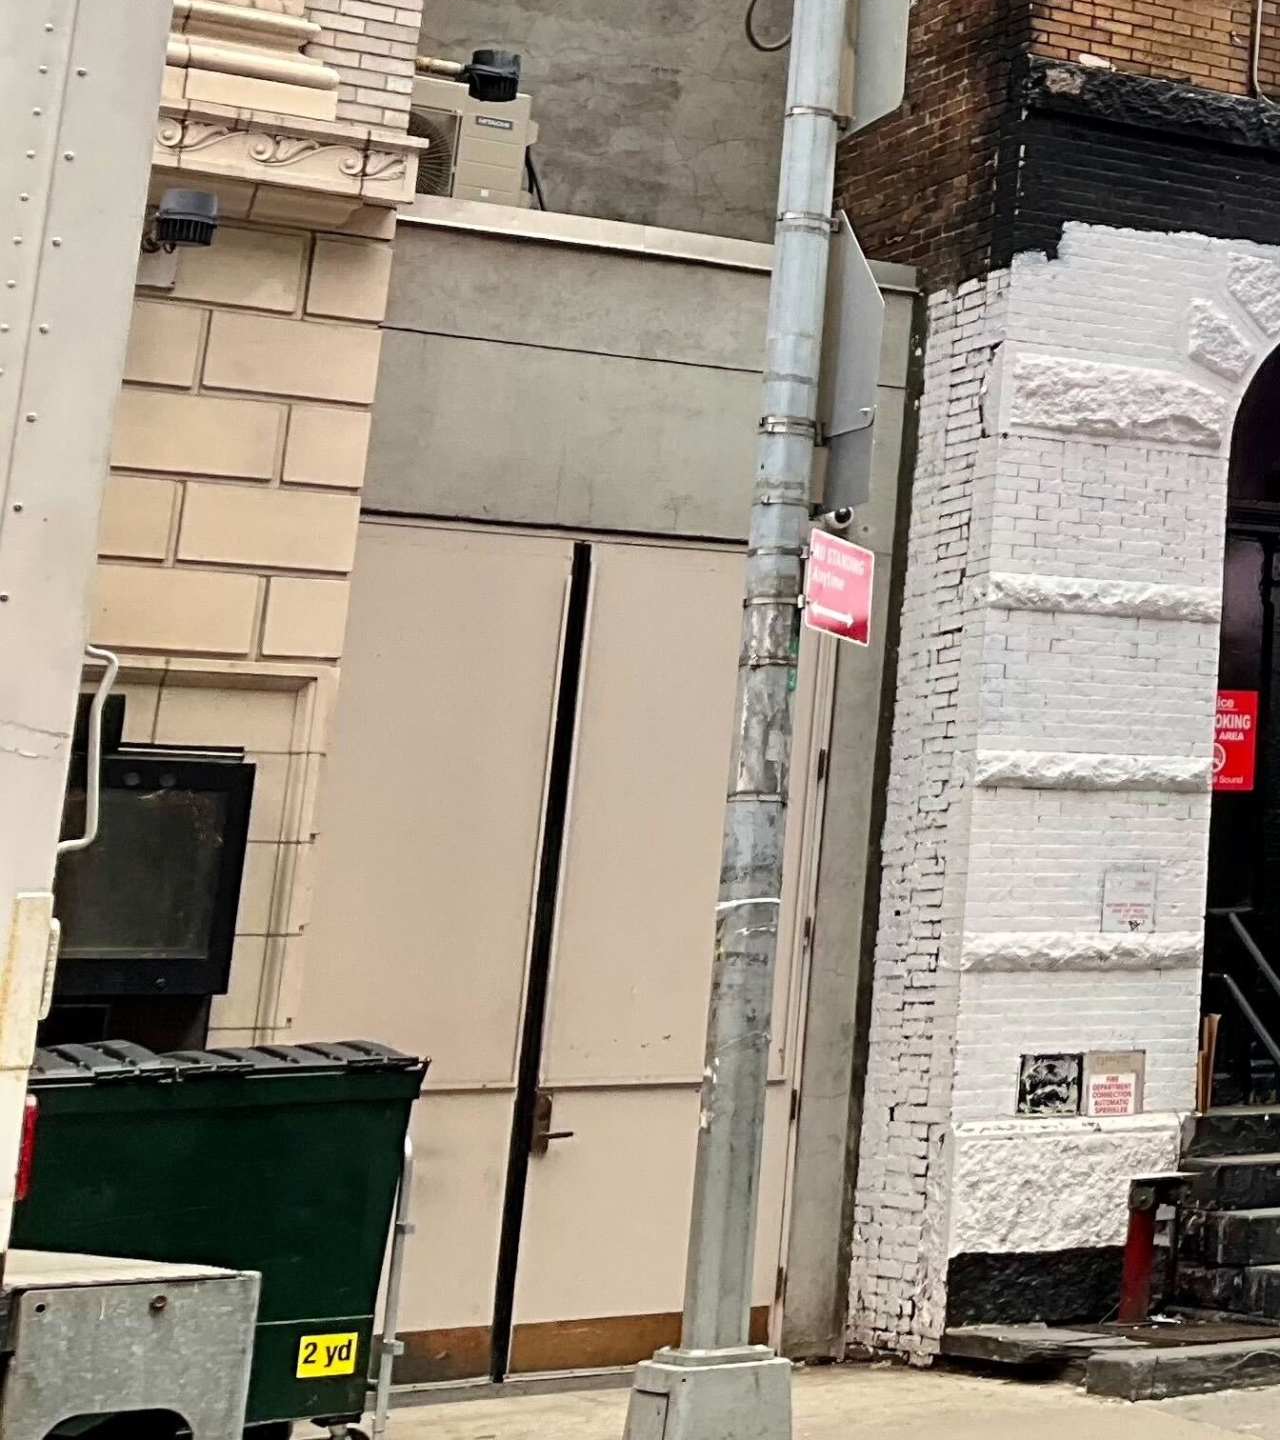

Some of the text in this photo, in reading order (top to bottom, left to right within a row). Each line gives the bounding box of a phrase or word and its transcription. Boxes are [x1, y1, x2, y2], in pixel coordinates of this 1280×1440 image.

[813, 542, 865, 577] NO STANDING
[812, 565, 846, 592] Anytime
[1217, 696, 1235, 708] ice
[1216, 714, 1251, 729] OKING
[1219, 731, 1245, 741] AREA
[1092, 1091, 1132, 1099] CONNECTION
[302, 1338, 353, 1368] 2 yd
